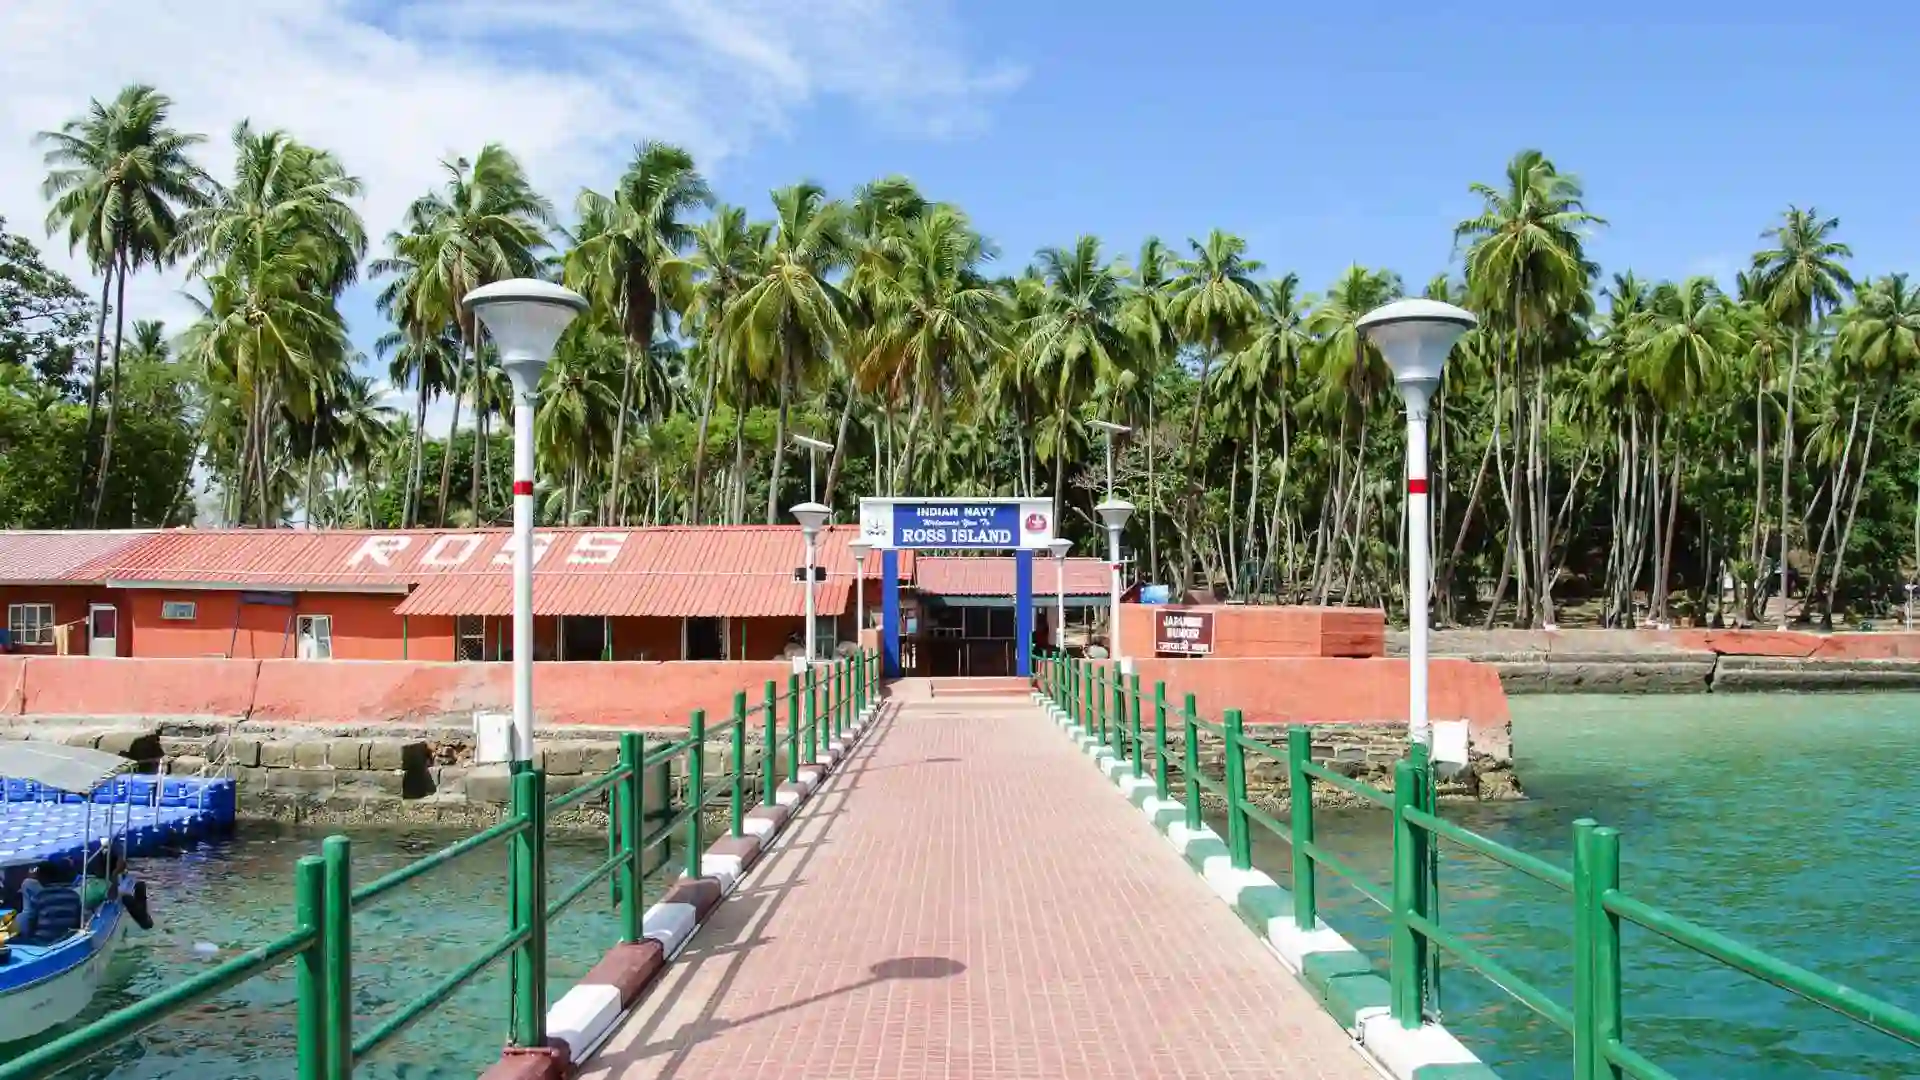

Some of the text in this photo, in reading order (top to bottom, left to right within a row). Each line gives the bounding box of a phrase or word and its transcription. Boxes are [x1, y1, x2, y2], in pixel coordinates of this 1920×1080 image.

[917, 507, 996, 517] INDIAN NAVY
[902, 528, 1011, 544] ROSS ISLAND
[346, 532, 632, 568] ROSS
[1163, 615, 1203, 628] JAPA
